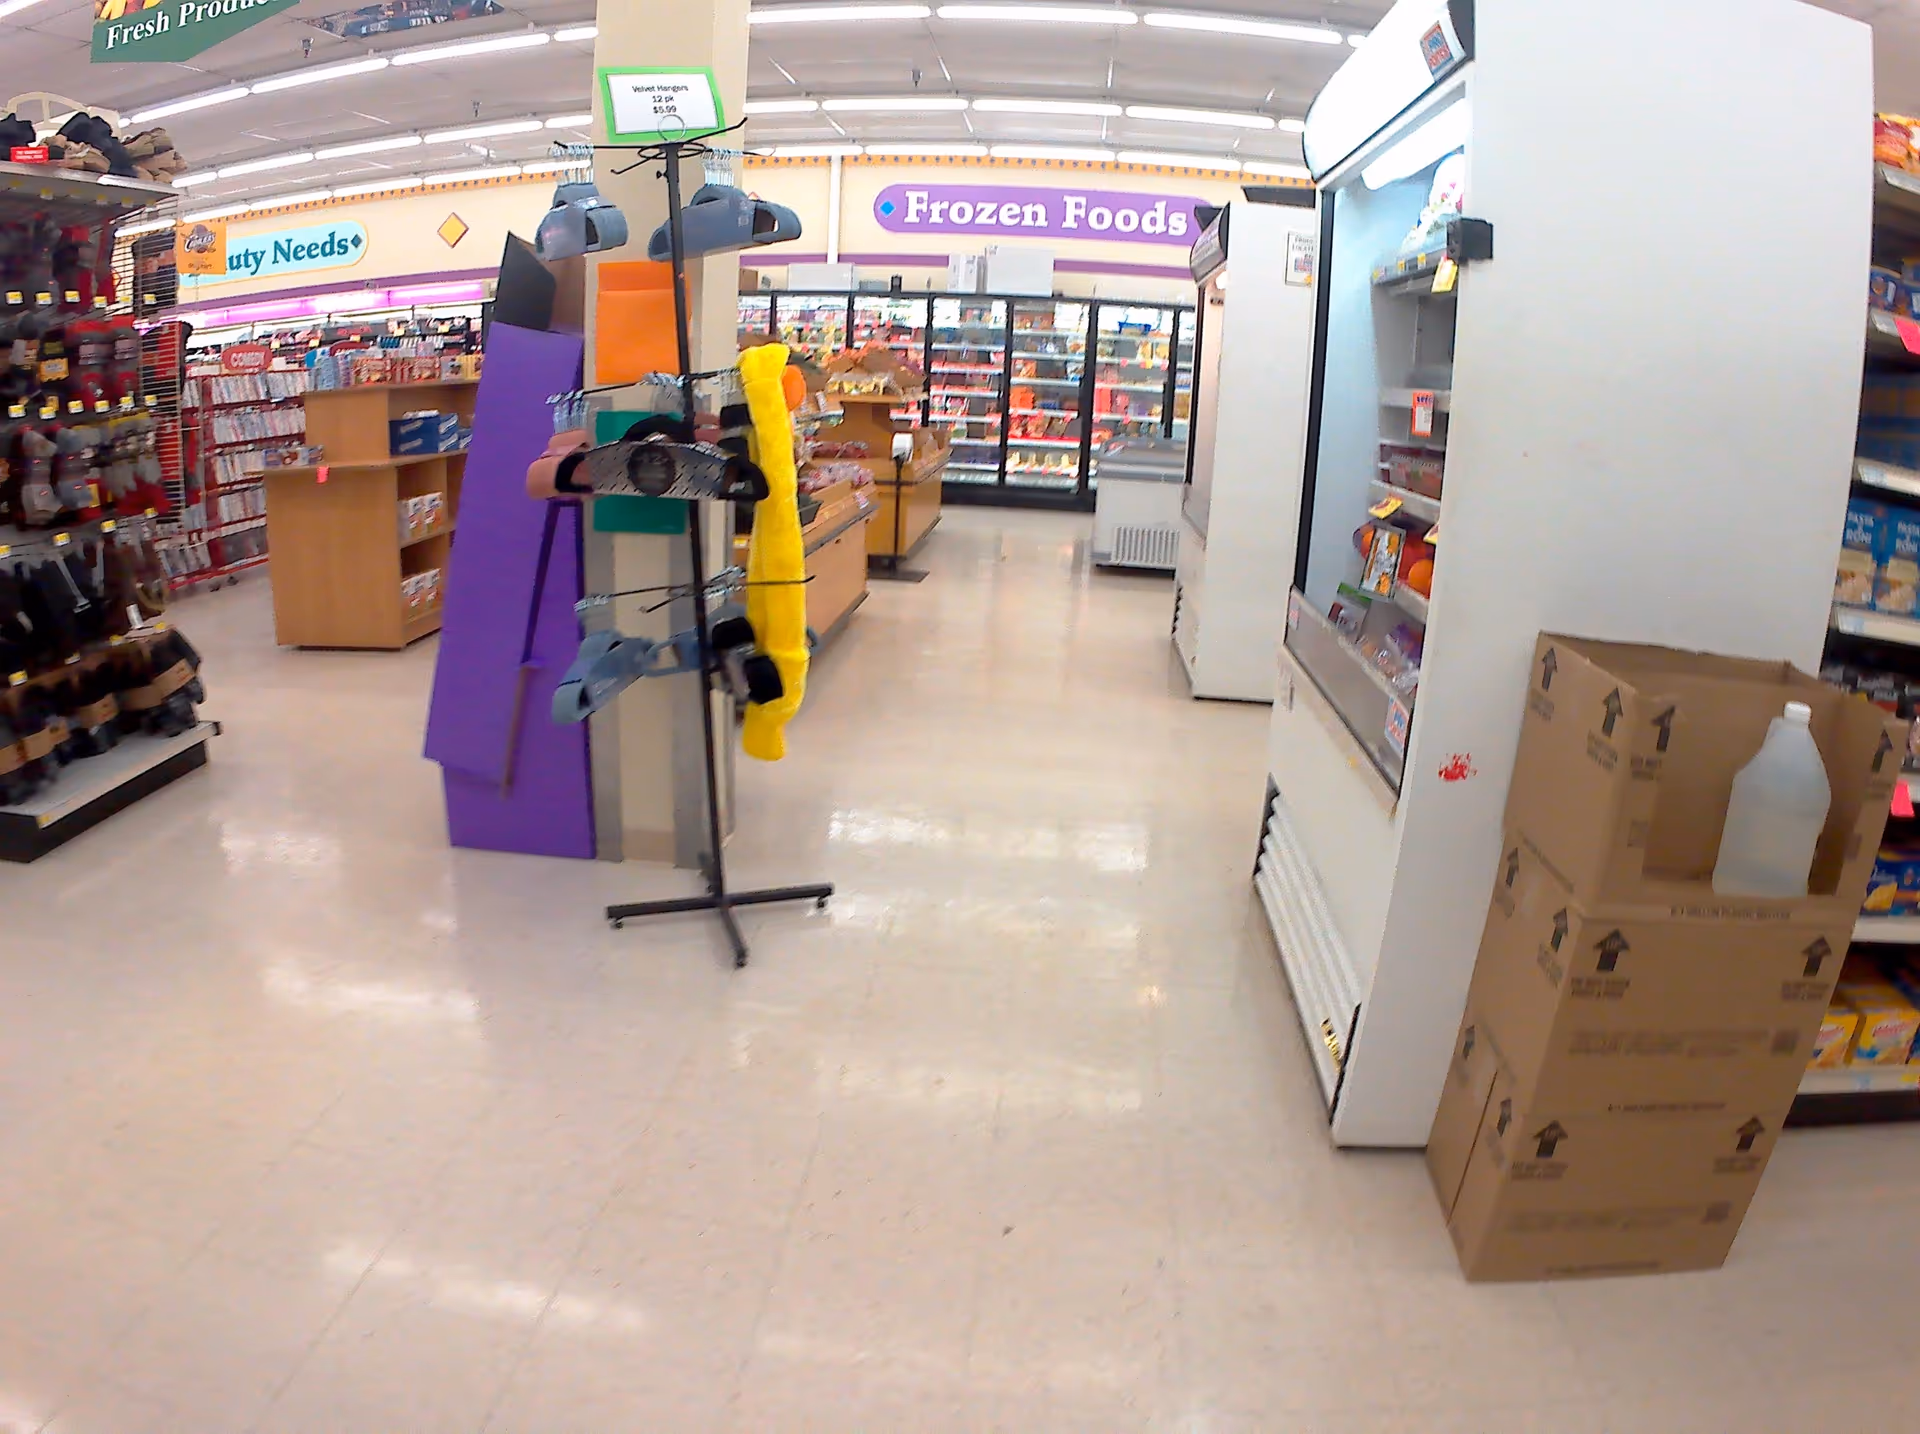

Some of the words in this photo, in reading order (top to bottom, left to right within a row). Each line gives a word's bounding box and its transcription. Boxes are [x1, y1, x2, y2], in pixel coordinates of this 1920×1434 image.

[105, 11, 170, 50] Fresh
[177, 0, 276, 29] Produ
[632, 85, 655, 93] Velvet
[656, 85, 689, 93] Hangers
[652, 95, 663, 103] 12
[664, 95, 675, 103] pk
[653, 105, 677, 114] $5.99
[903, 190, 1048, 227] Frozen
[1061, 194, 1188, 236] Foods
[271, 231, 349, 264] Needs
[230, 351, 265, 368] COMEDY
